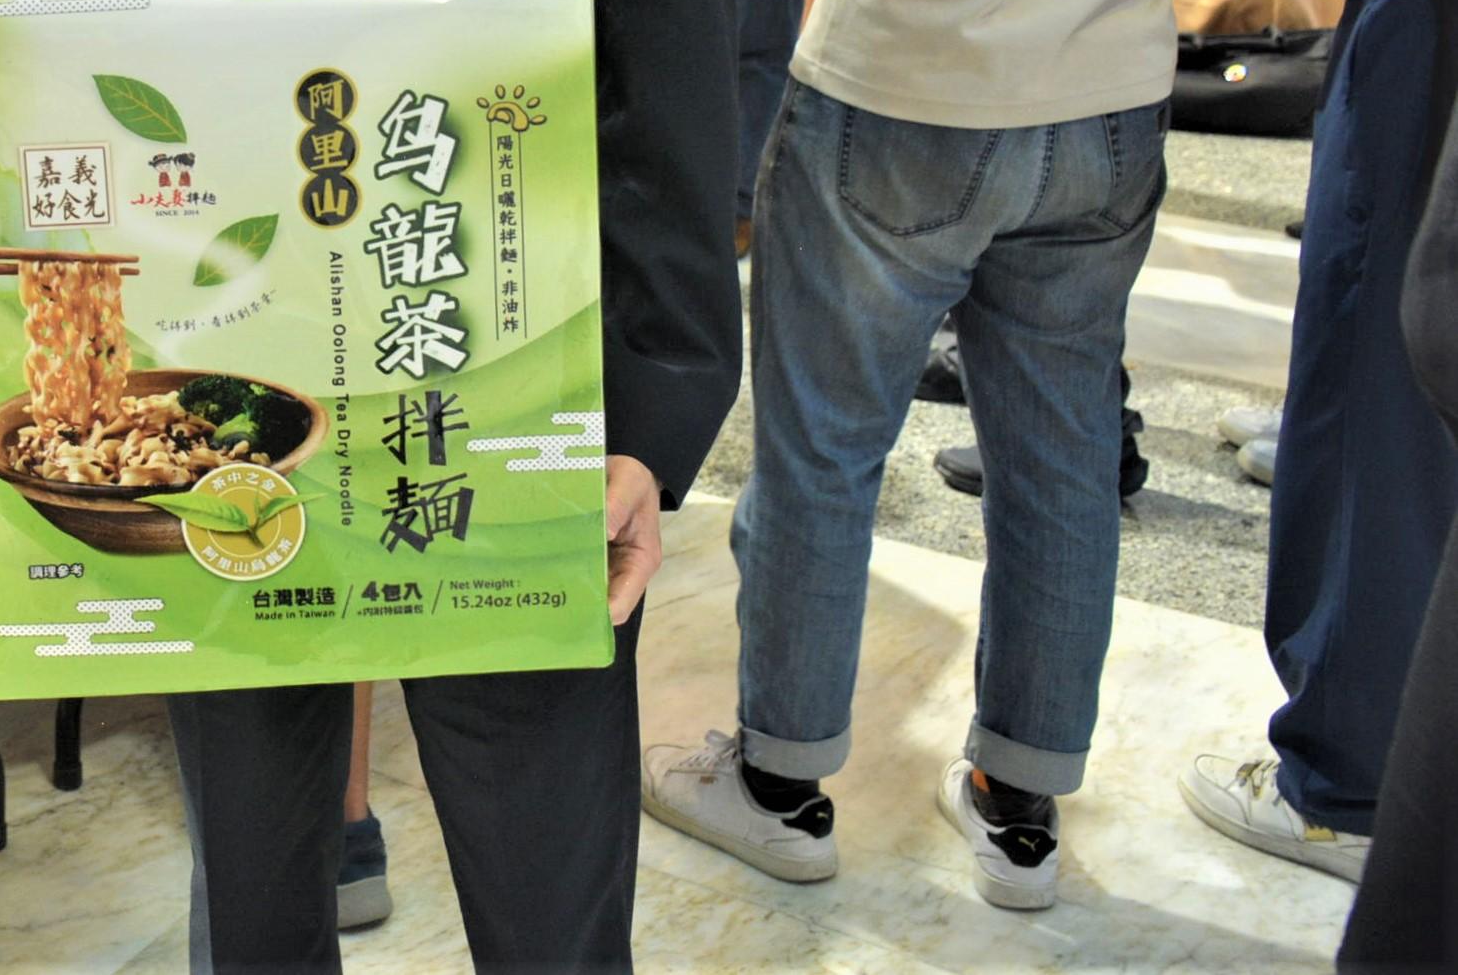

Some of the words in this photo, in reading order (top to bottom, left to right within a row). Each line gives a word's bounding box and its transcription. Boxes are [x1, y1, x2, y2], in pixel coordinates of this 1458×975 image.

[305, 78, 352, 220] 阿里山
[35, 154, 98, 188] 嘉義
[32, 188, 106, 221] 好食光
[328, 250, 343, 317] Alishan
[331, 325, 347, 387] Oolong
[335, 393, 350, 422] Tea
[334, 429, 351, 459] Dry
[338, 465, 354, 526] Noodle
[252, 587, 336, 609] 台灣製造
[361, 581, 423, 602] 4包入
[449, 580, 471, 591] Net
[451, 595, 512, 610] 15.24oz
[516, 591, 567, 609] (432g)
[255, 611, 283, 621] Made
[286, 611, 296, 620] in
[299, 609, 335, 619] Taiwan
